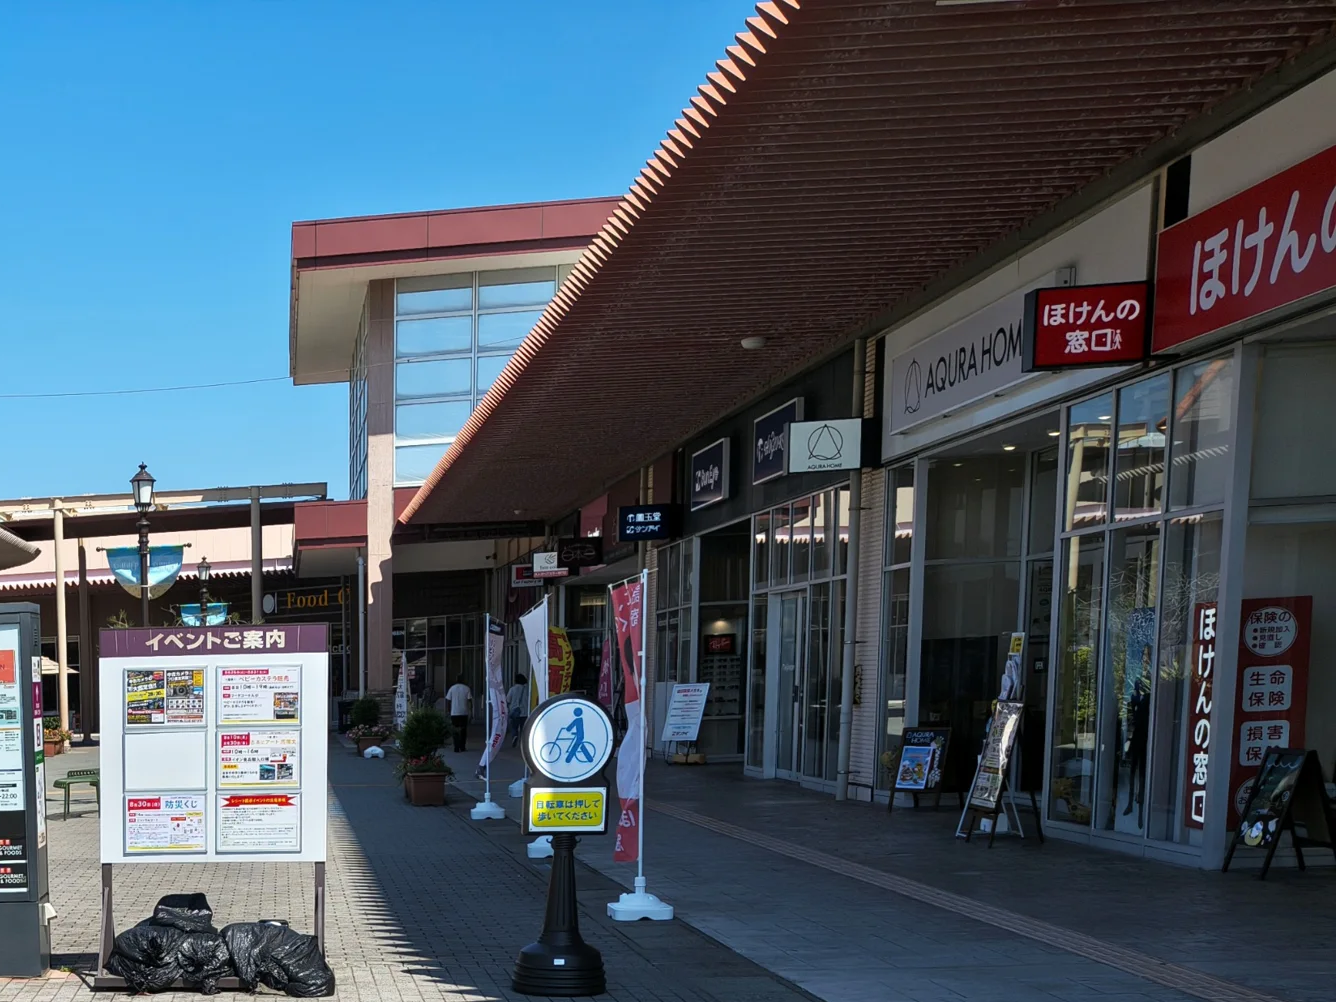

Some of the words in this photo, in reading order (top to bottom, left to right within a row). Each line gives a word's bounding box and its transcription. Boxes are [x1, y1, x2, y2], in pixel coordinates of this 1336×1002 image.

[1043, 299, 1140, 327] ほけんの
[924, 346, 978, 399] AQURA
[980, 318, 1022, 378] HOM
[286, 589, 329, 609] Food
[1250, 610, 1292, 624] 保険の
[145, 629, 286, 651] イベントご案内
[1249, 669, 1286, 687] 生命
[1248, 690, 1286, 708] 保険
[1190, 606, 1218, 824] ほけんの窓口
[1246, 725, 1284, 742] 損害
[164, 799, 198, 809] 防災くじ
[536, 799, 601, 809] 自転車は押して
[537, 811, 598, 822] 歩いてください
